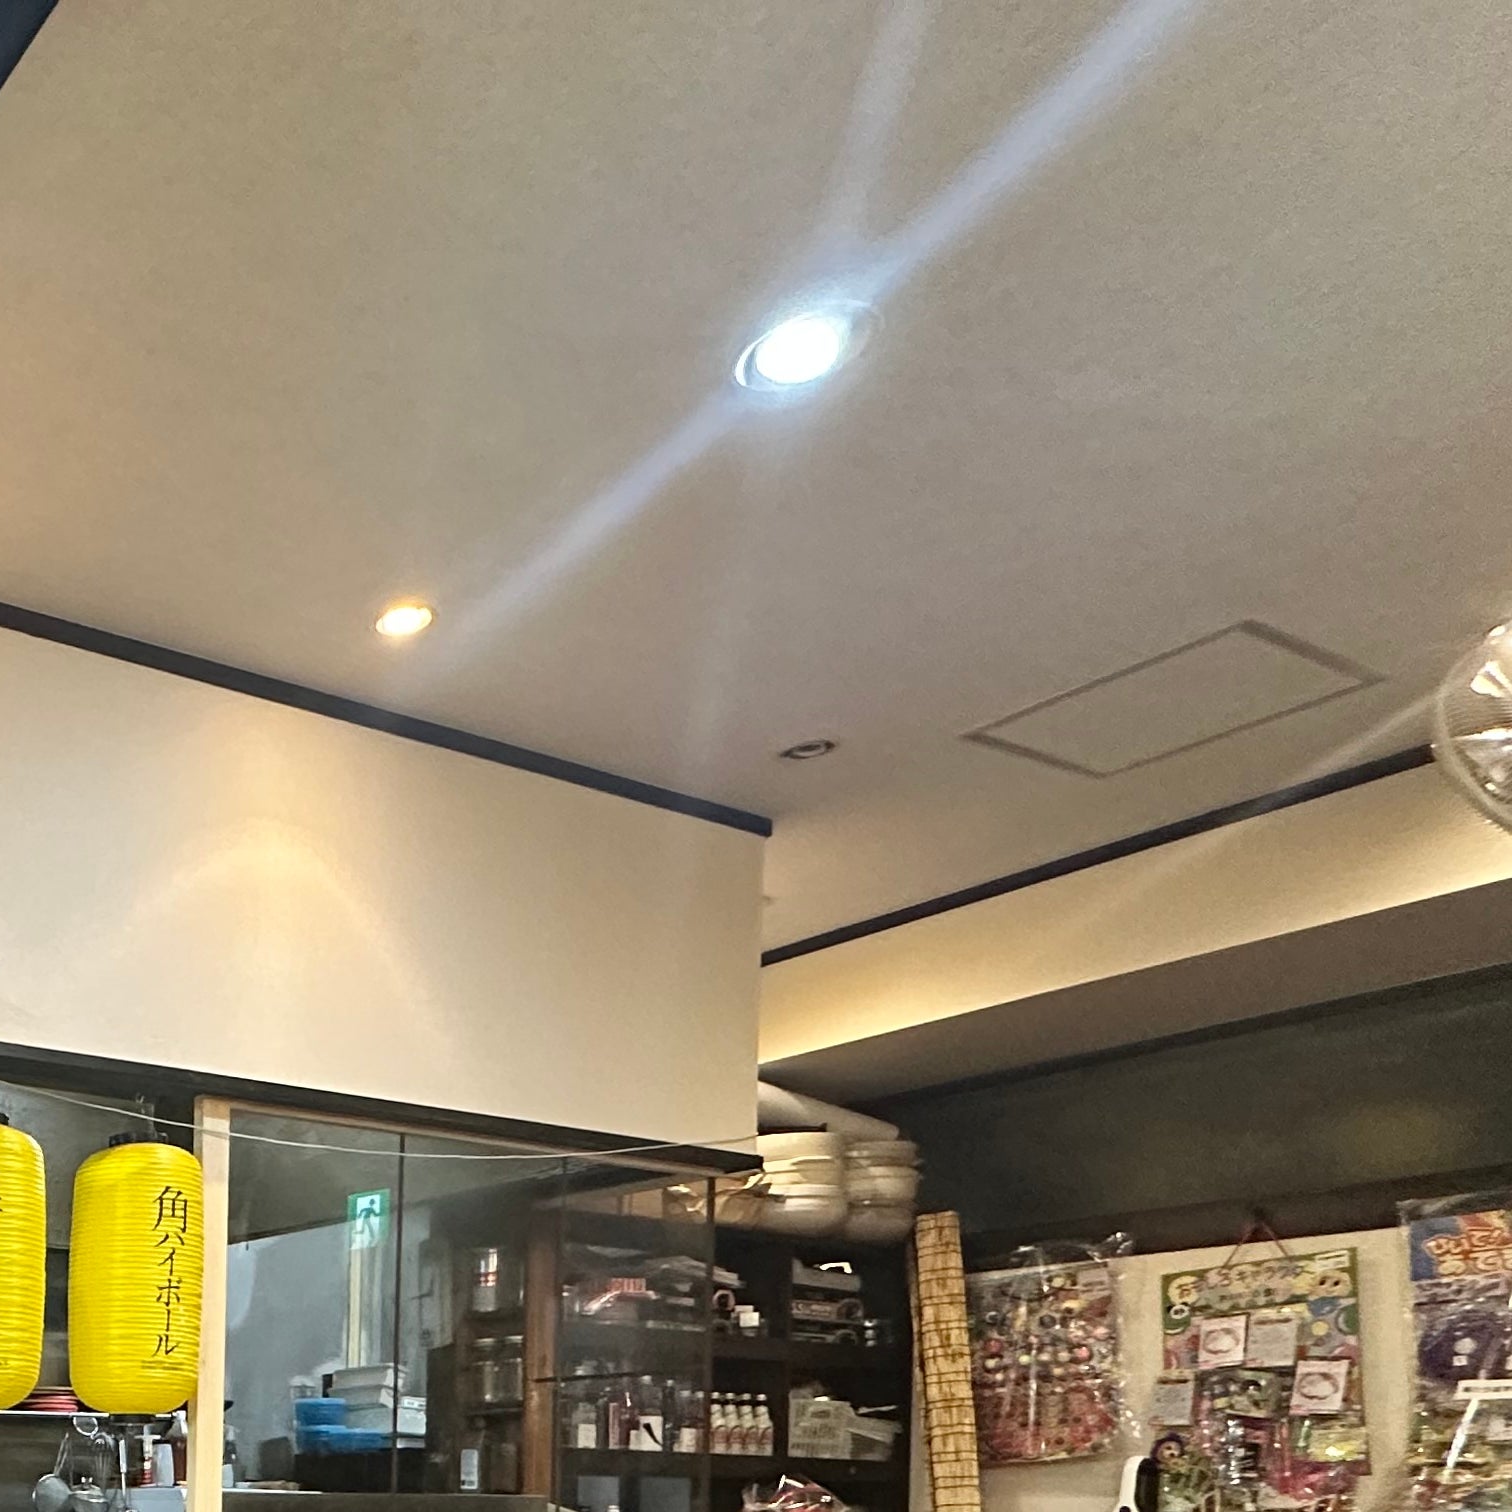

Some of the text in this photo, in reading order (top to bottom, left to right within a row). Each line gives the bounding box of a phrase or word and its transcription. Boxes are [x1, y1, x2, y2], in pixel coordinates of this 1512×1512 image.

[152, 1185, 188, 1359] 角ハイボール
